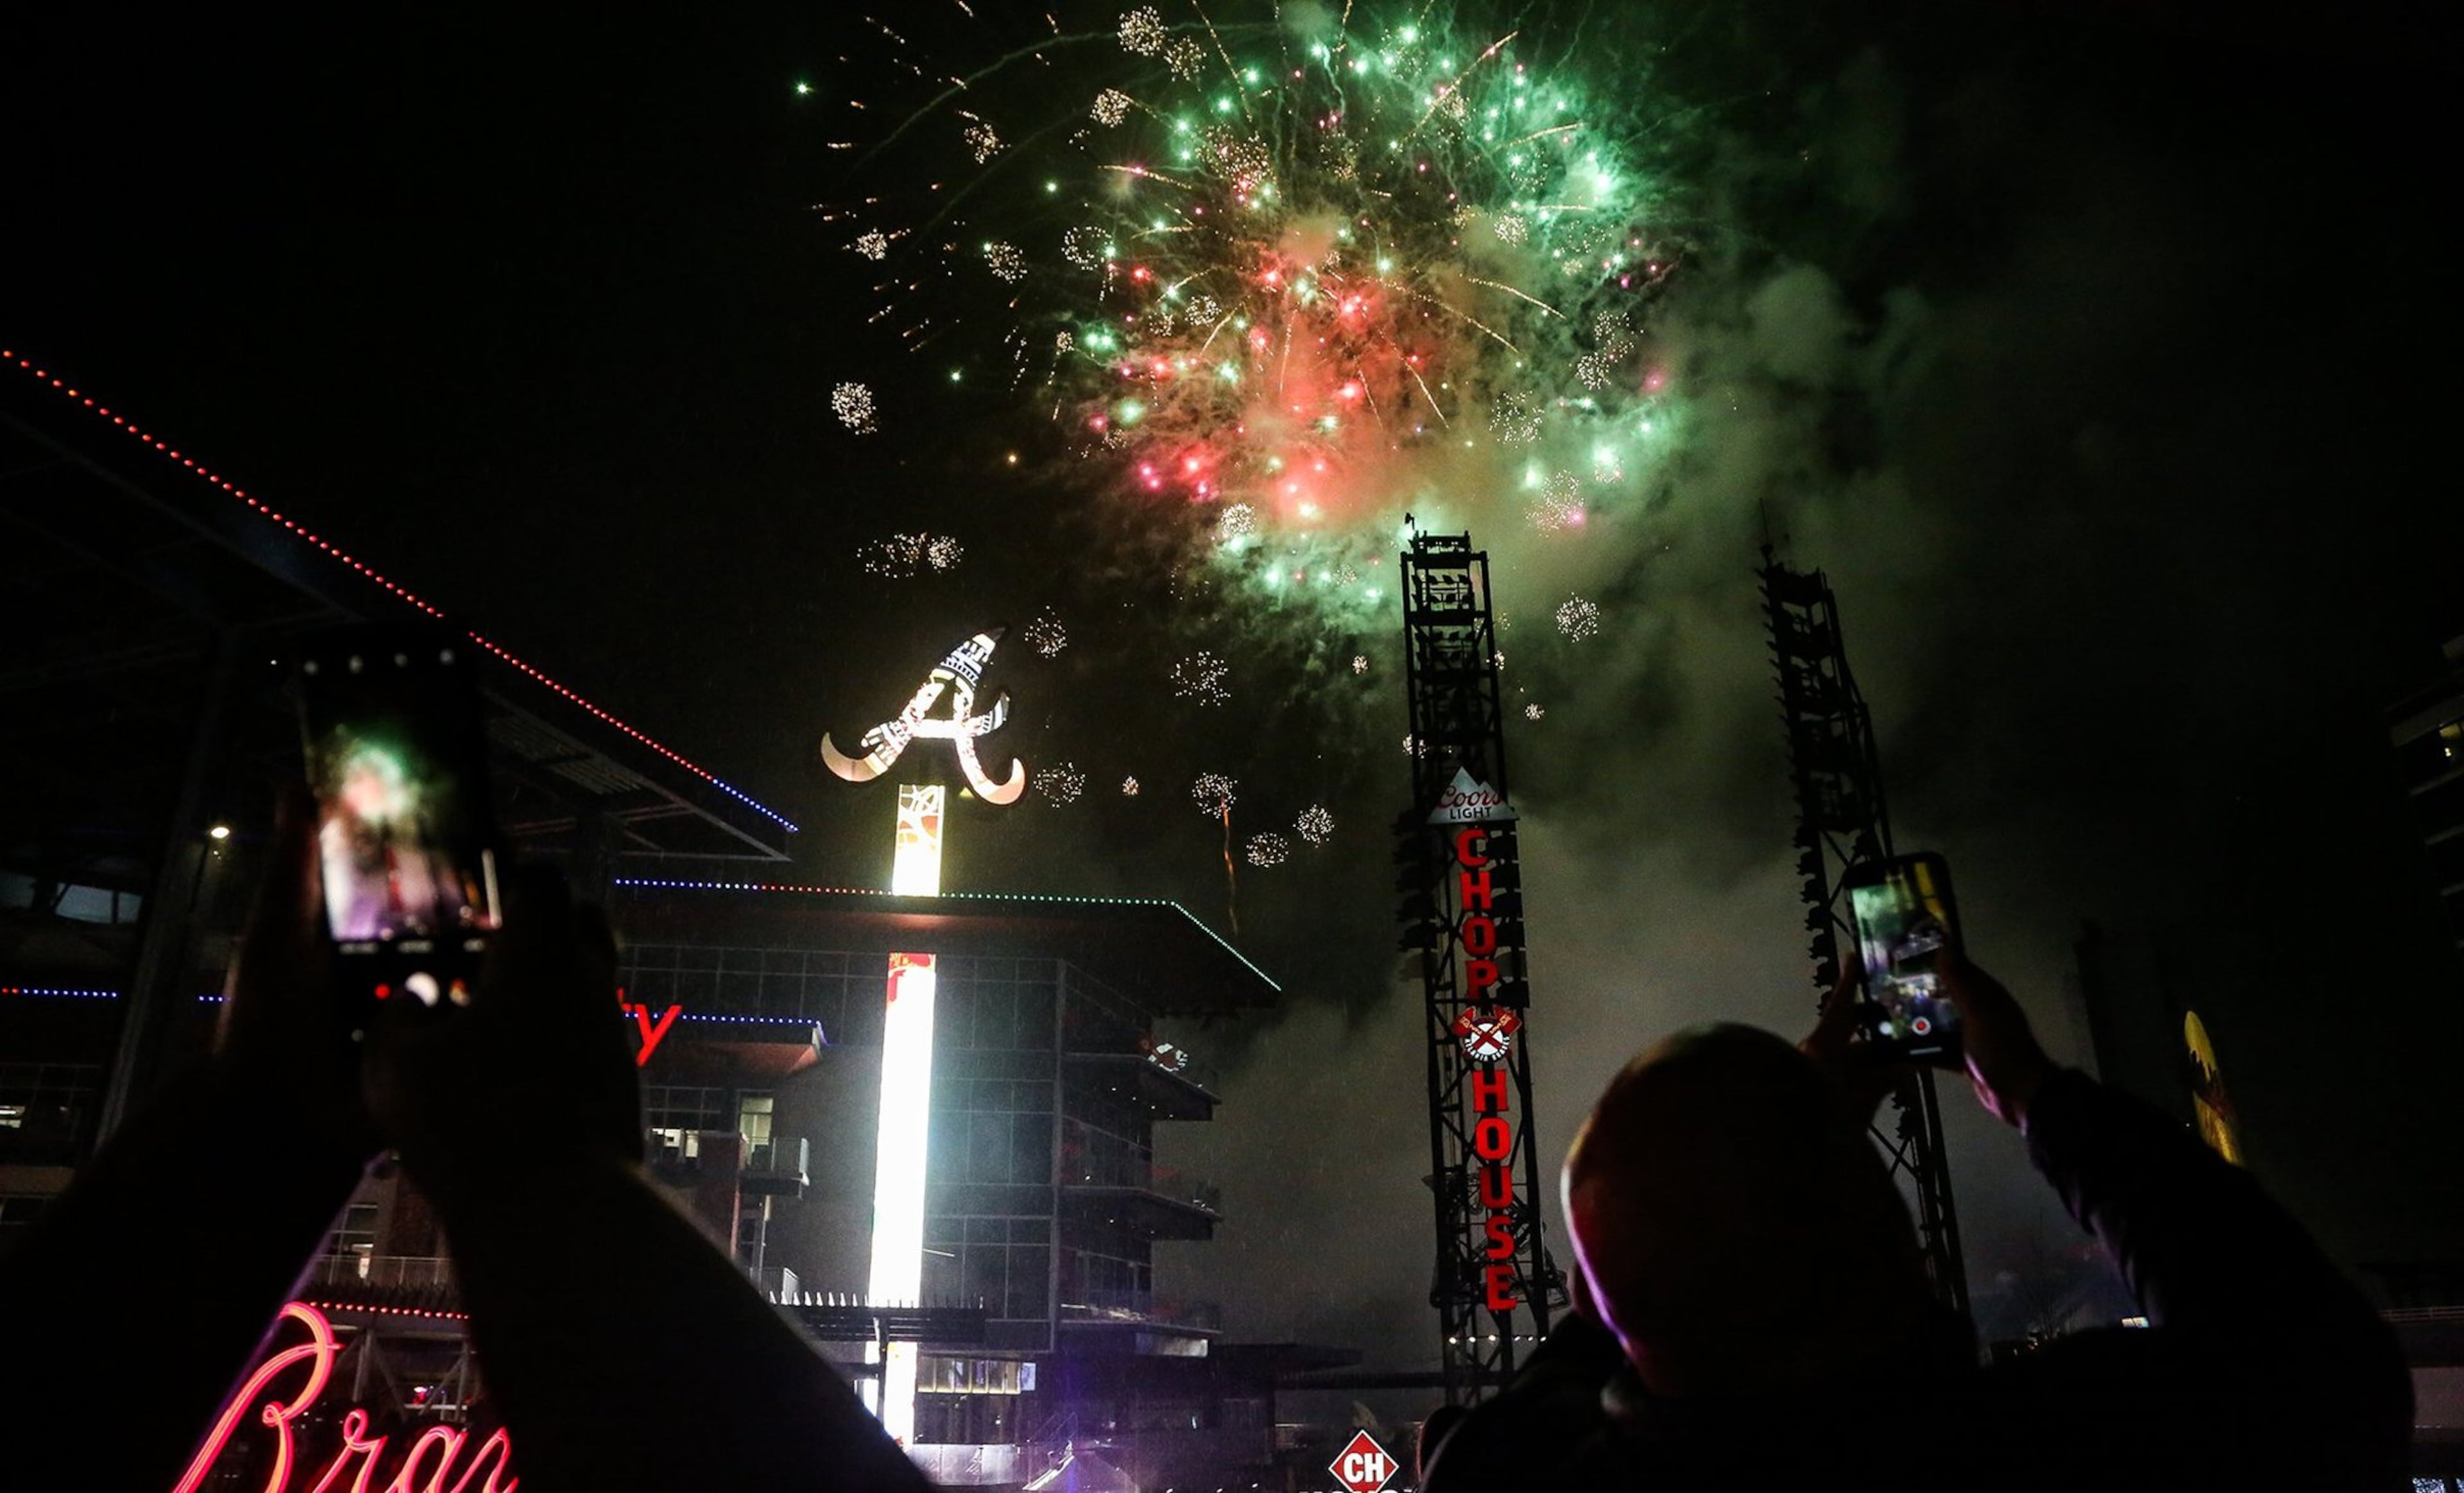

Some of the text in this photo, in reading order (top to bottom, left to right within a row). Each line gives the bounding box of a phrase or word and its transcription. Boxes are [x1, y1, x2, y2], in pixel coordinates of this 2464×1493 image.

[1437, 785, 1503, 809] Coors
[1450, 806, 1491, 819] LIGHT
[1456, 828, 1518, 1311] CHOP HOUSE
[1343, 1452, 1385, 1483] CH
